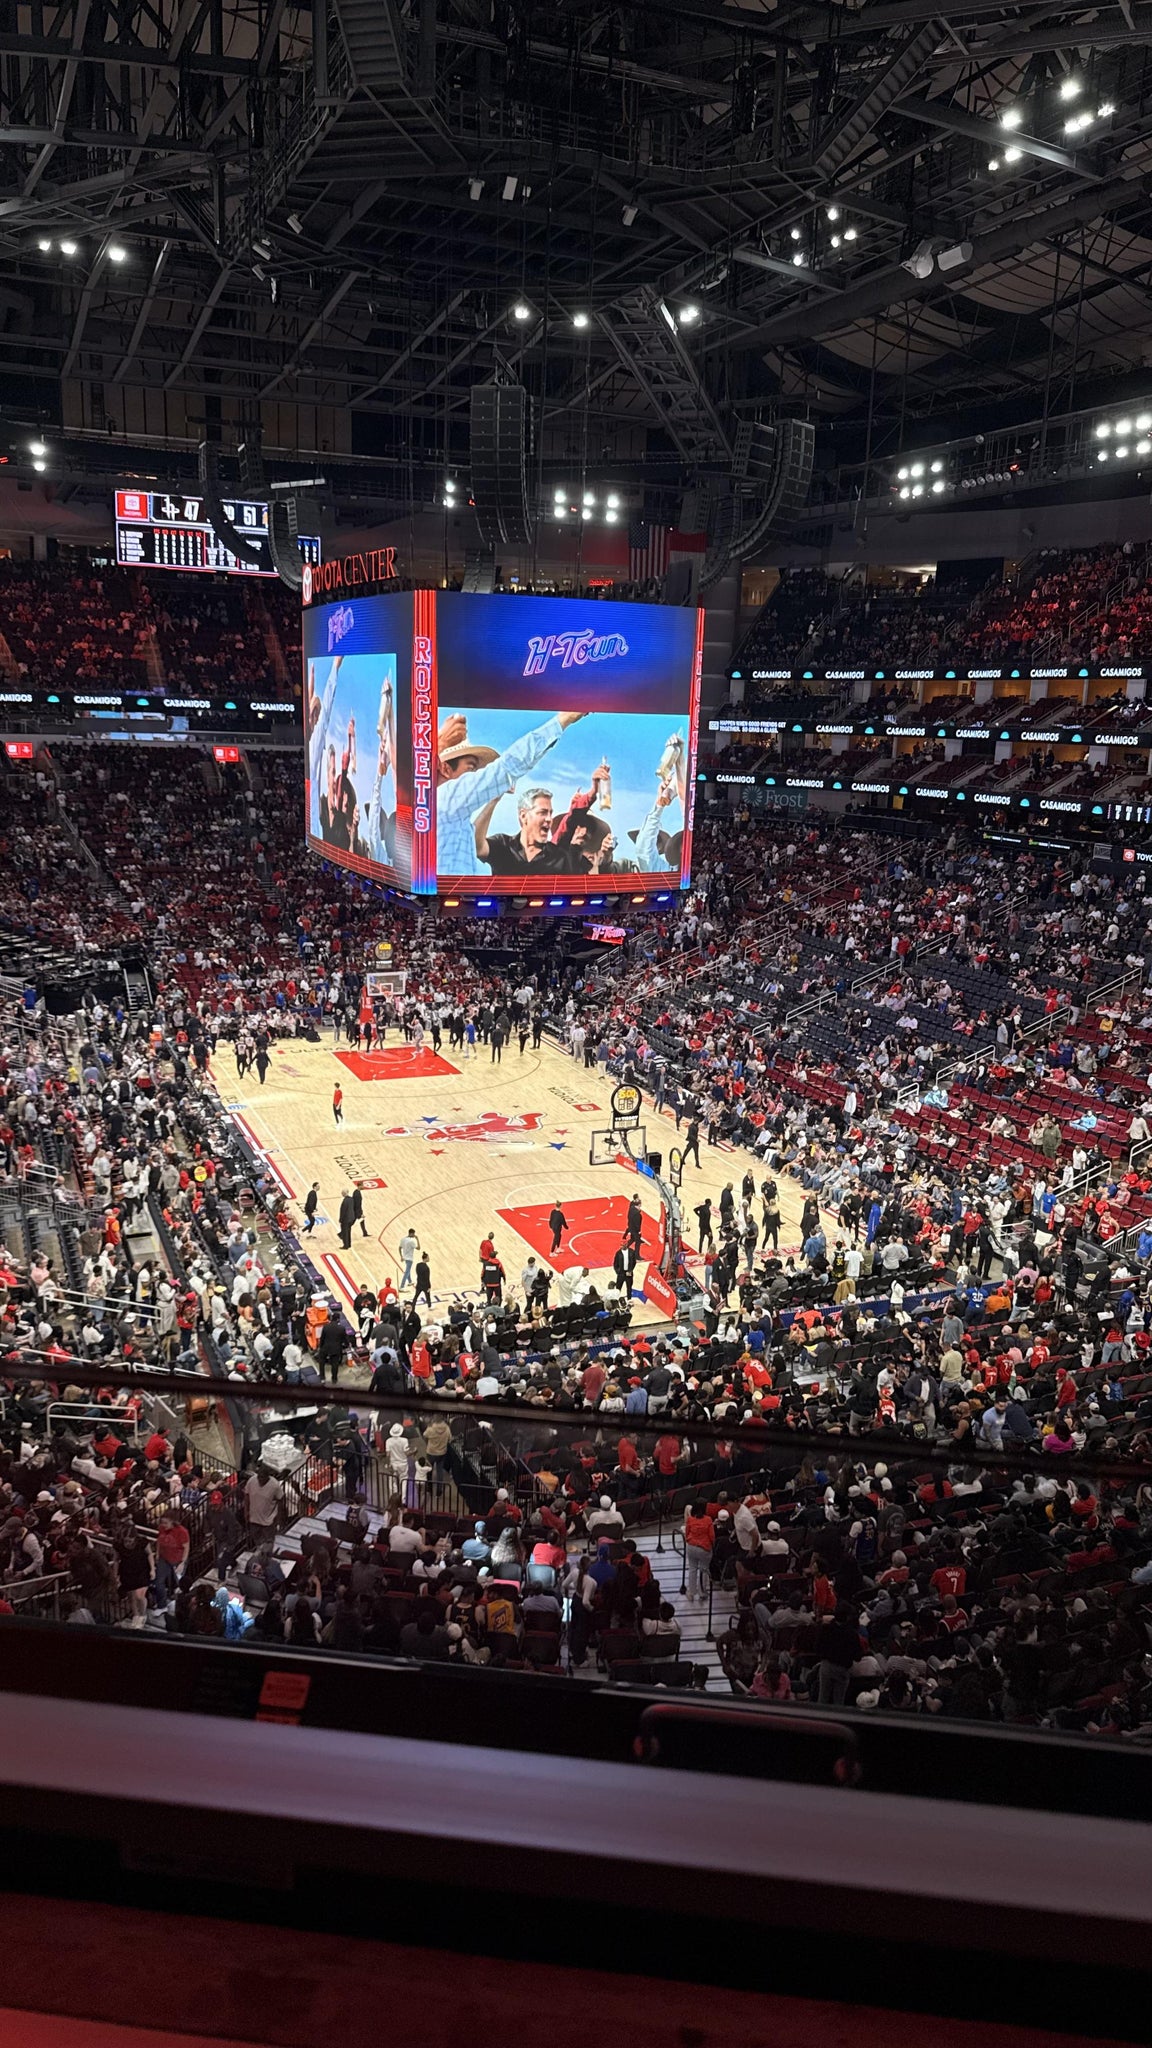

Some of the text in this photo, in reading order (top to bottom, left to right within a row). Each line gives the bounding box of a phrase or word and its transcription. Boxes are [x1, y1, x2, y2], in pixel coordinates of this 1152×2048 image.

[183, 501, 200, 521] 47
[243, 505, 257, 526] 51
[312, 547, 398, 594] TOYOTA CENTER
[523, 628, 630, 677] H-Town
[753, 671, 791, 679] CASAMIGOS
[825, 671, 865, 679] CASAMIGOS
[895, 671, 934, 679] CASAMIGOS
[968, 670, 1001, 678] CASAMIGOS
[1030, 669, 1067, 678] CASAMIGOS
[1100, 668, 1142, 677] CASAMIGOS
[74, 696, 122, 706] CASAMIGOS
[164, 699, 211, 709] CASAMIGOS
[250, 702, 296, 712] CASAMIGOS
[414, 636, 432, 833] ROCKETS
[816, 725, 853, 734] CASAMIGOS
[886, 727, 925, 736] CASAMIGOS
[956, 729, 990, 739] CASAMIGOS
[1021, 732, 1059, 741] CASAMIGOS
[1095, 735, 1139, 745] CASAMIGOS
[717, 775, 755, 784] CASAMIGOS
[786, 779, 824, 788] CASAMIGOS
[852, 783, 890, 793] CASAMIGOS
[916, 788, 949, 798] CASAMIGOS
[765, 789, 804, 808] Frost
[974, 794, 1011, 805] CASAMIGOS
[1040, 800, 1082, 812] CASAMIGOS
[333, 1155, 363, 1180] TOYOTA
[647, 1275, 671, 1299] coinbase
[415, 1351, 420, 1362] 5
[950, 1577, 958, 1593] 7
